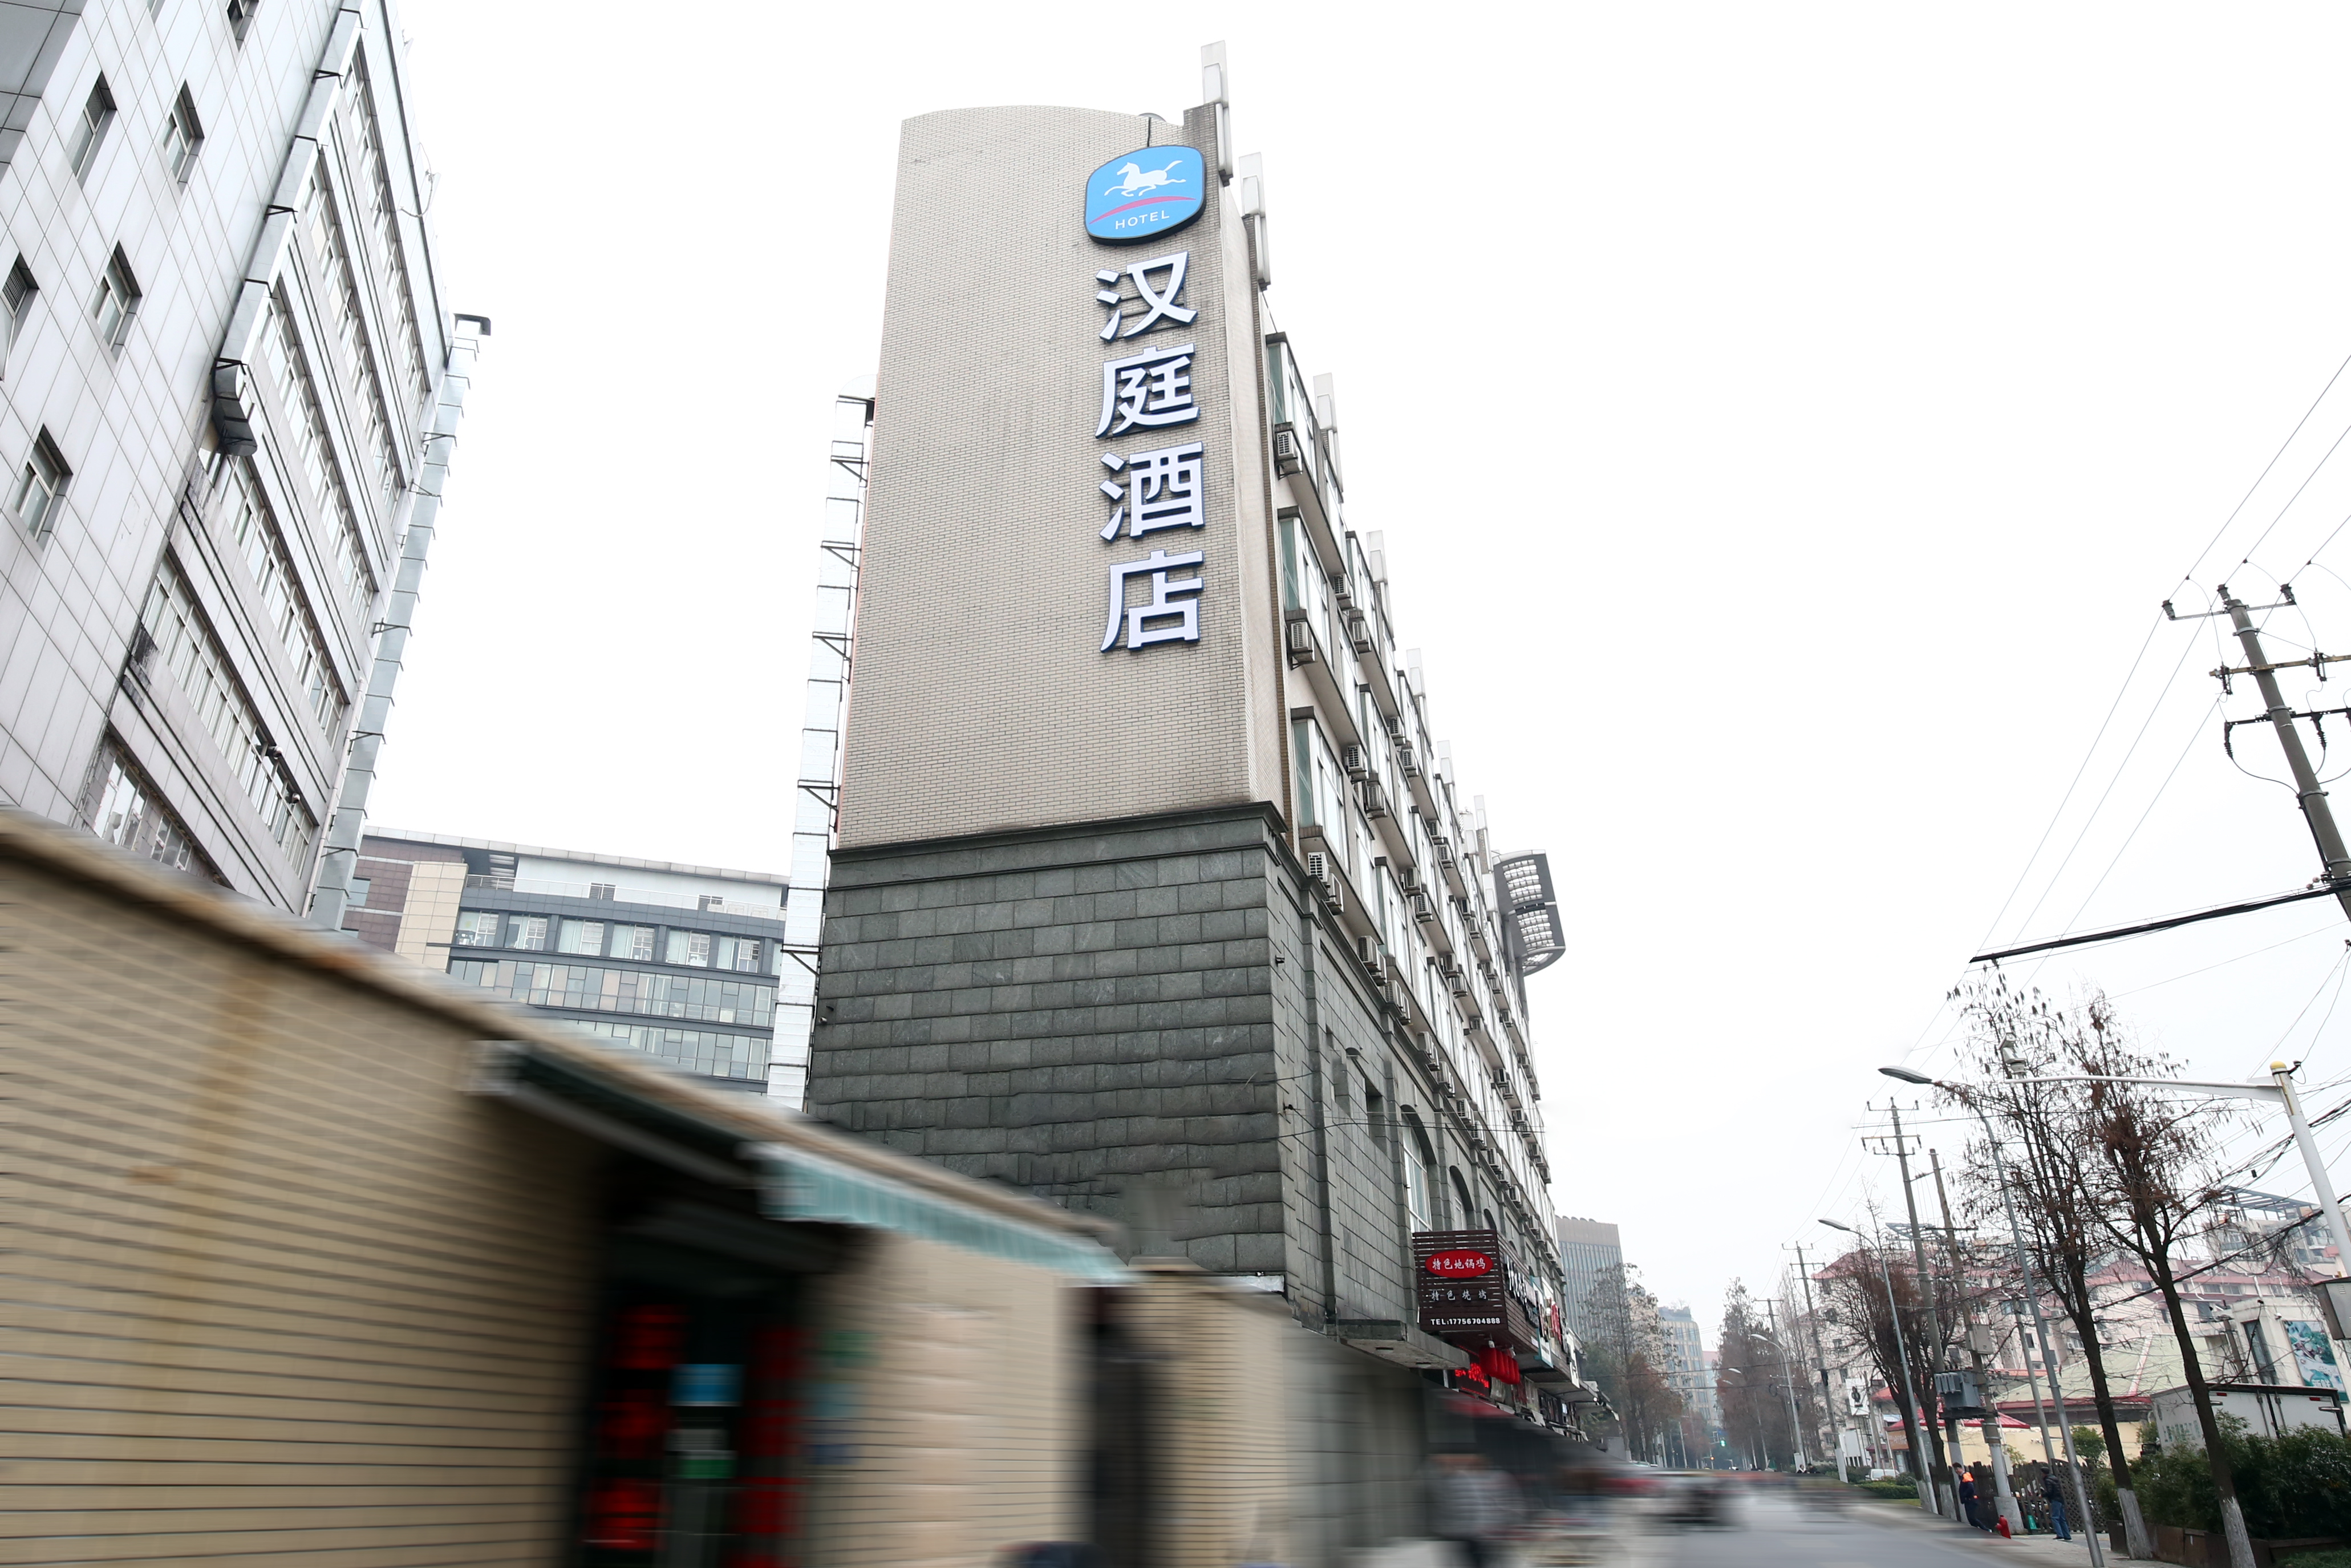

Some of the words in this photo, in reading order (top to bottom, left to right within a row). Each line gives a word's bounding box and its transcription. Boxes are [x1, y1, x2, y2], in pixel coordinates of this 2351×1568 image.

[1115, 210, 1170, 230] HOTEL
[1095, 250, 1205, 653] 汉庭酒店
[1432, 1258, 1486, 1270] 特色地锅鸡
[1431, 1289, 1487, 1301] 特色烧烤
